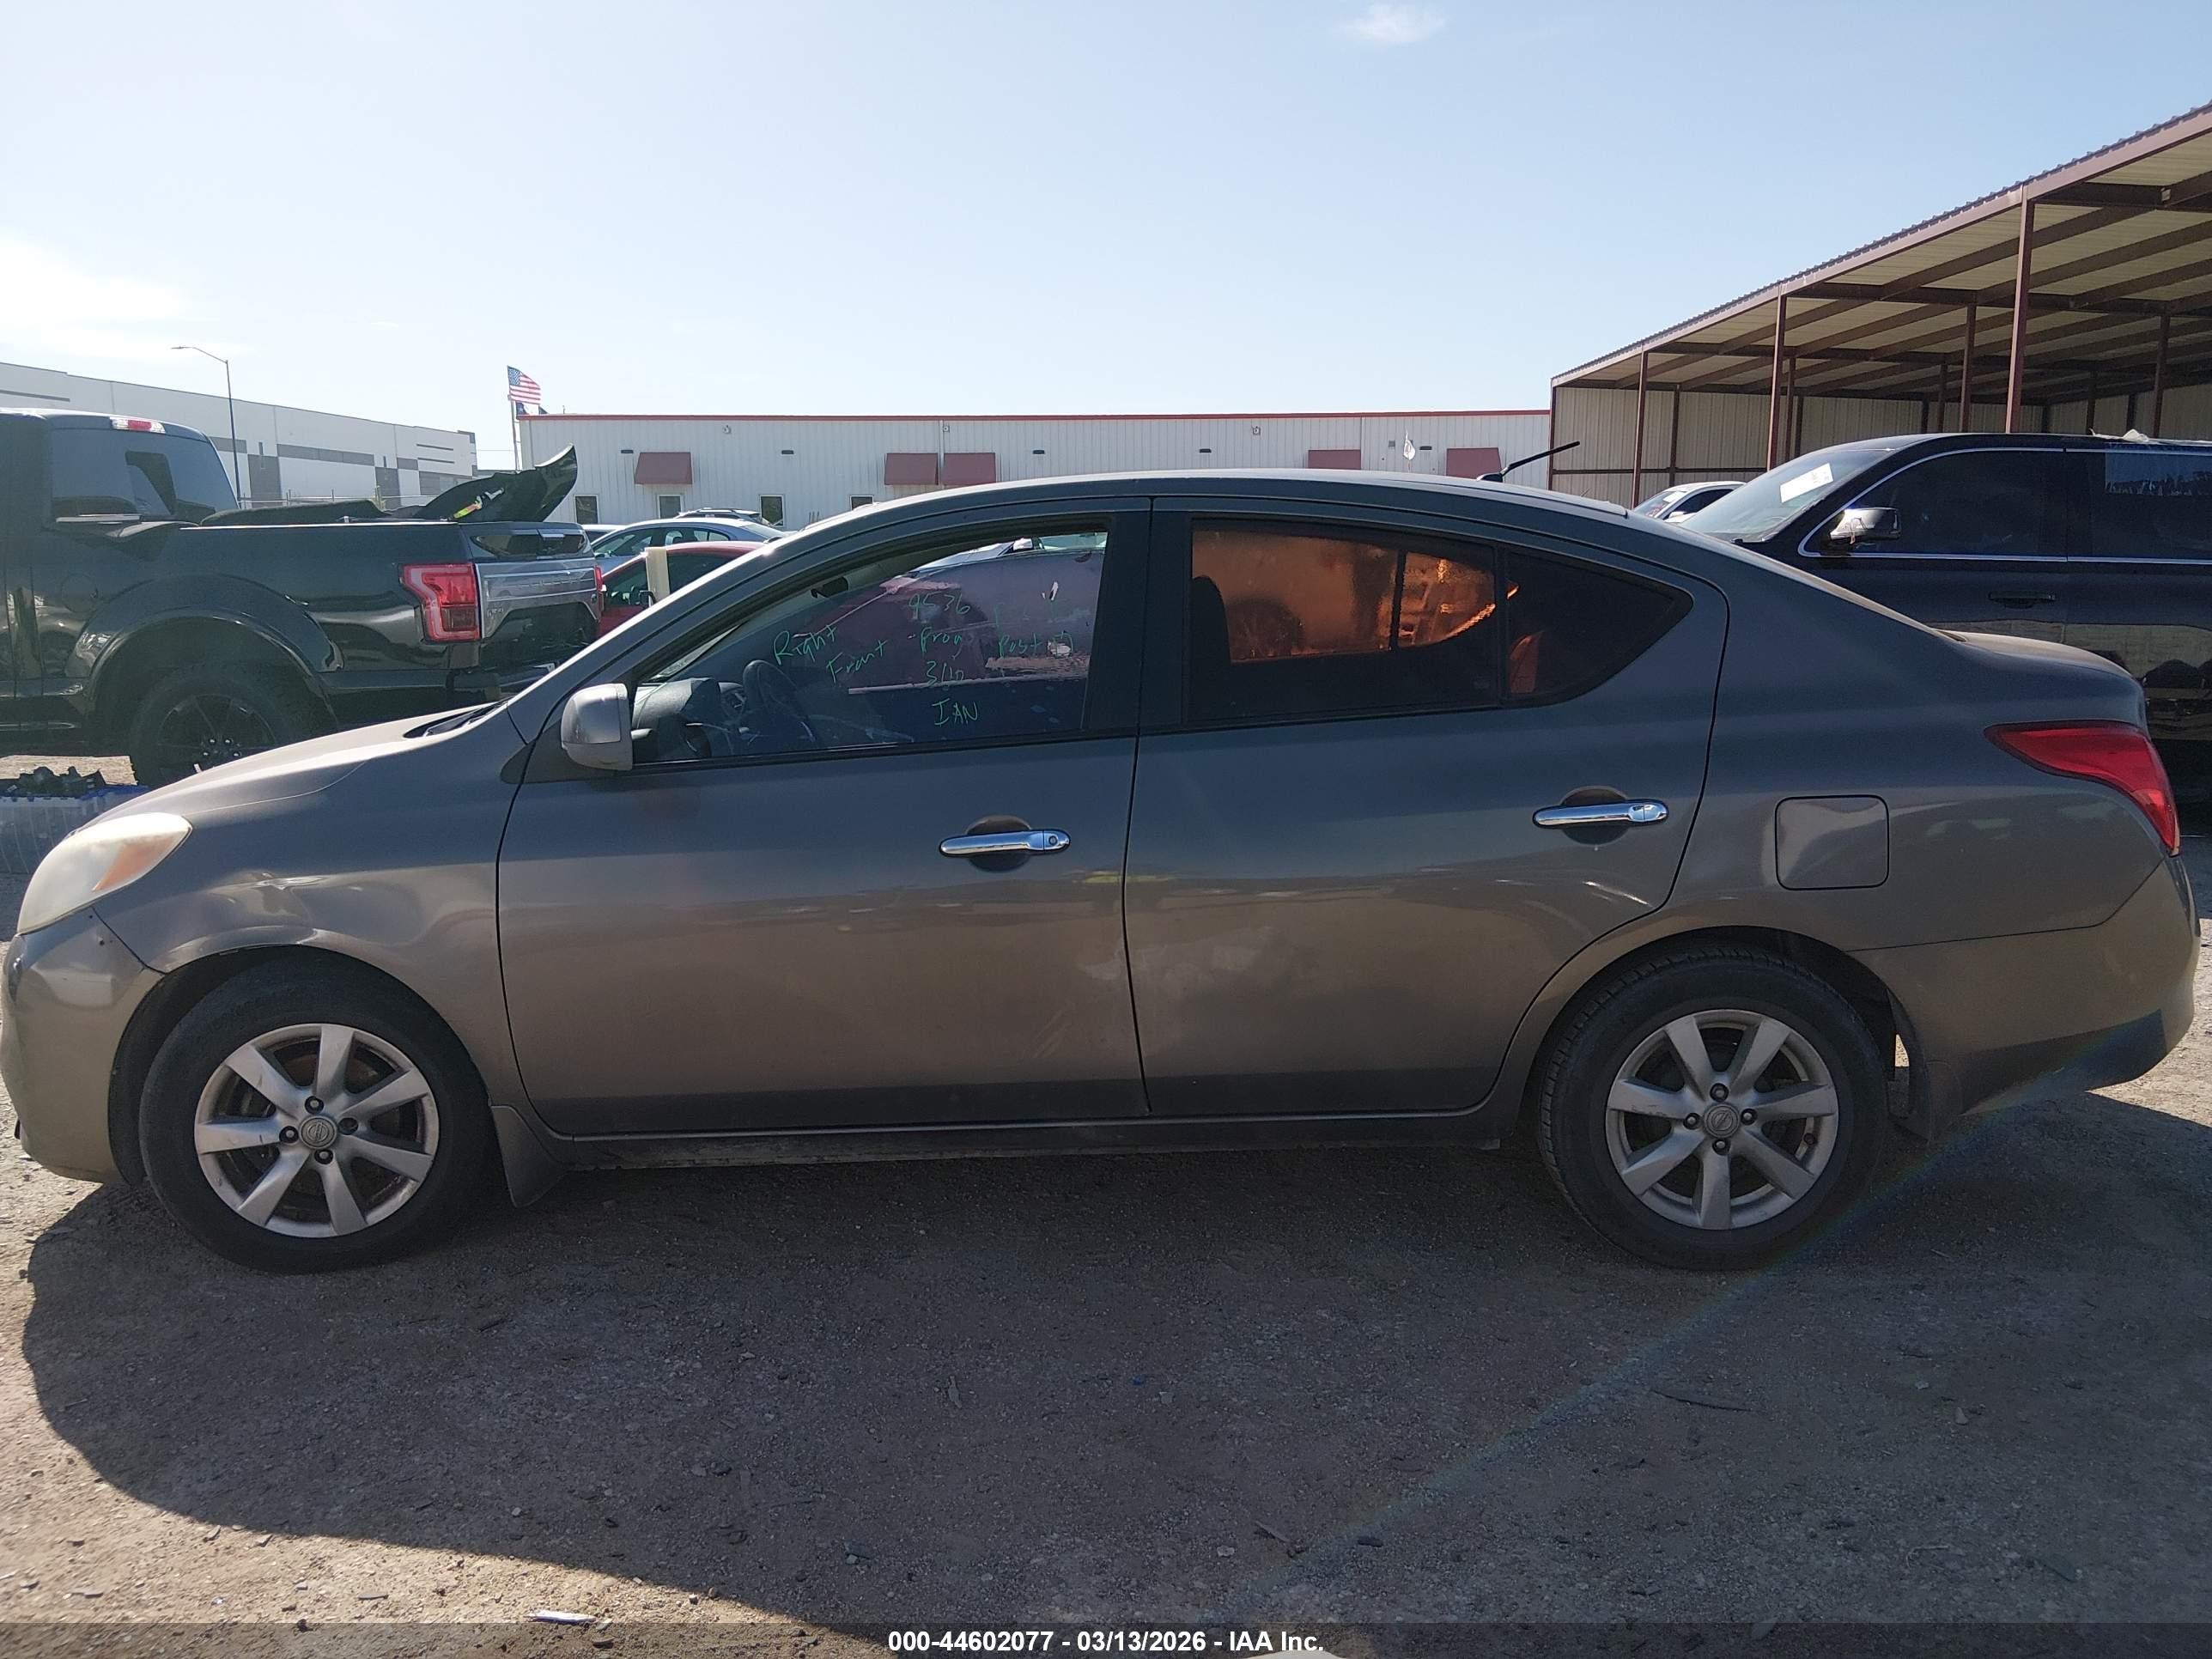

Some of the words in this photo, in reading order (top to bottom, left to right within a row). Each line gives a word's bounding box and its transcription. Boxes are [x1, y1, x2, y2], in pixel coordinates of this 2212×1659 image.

[773, 624, 838, 665] Right
[826, 639, 889, 684] Front
[932, 698, 978, 727] IAN
